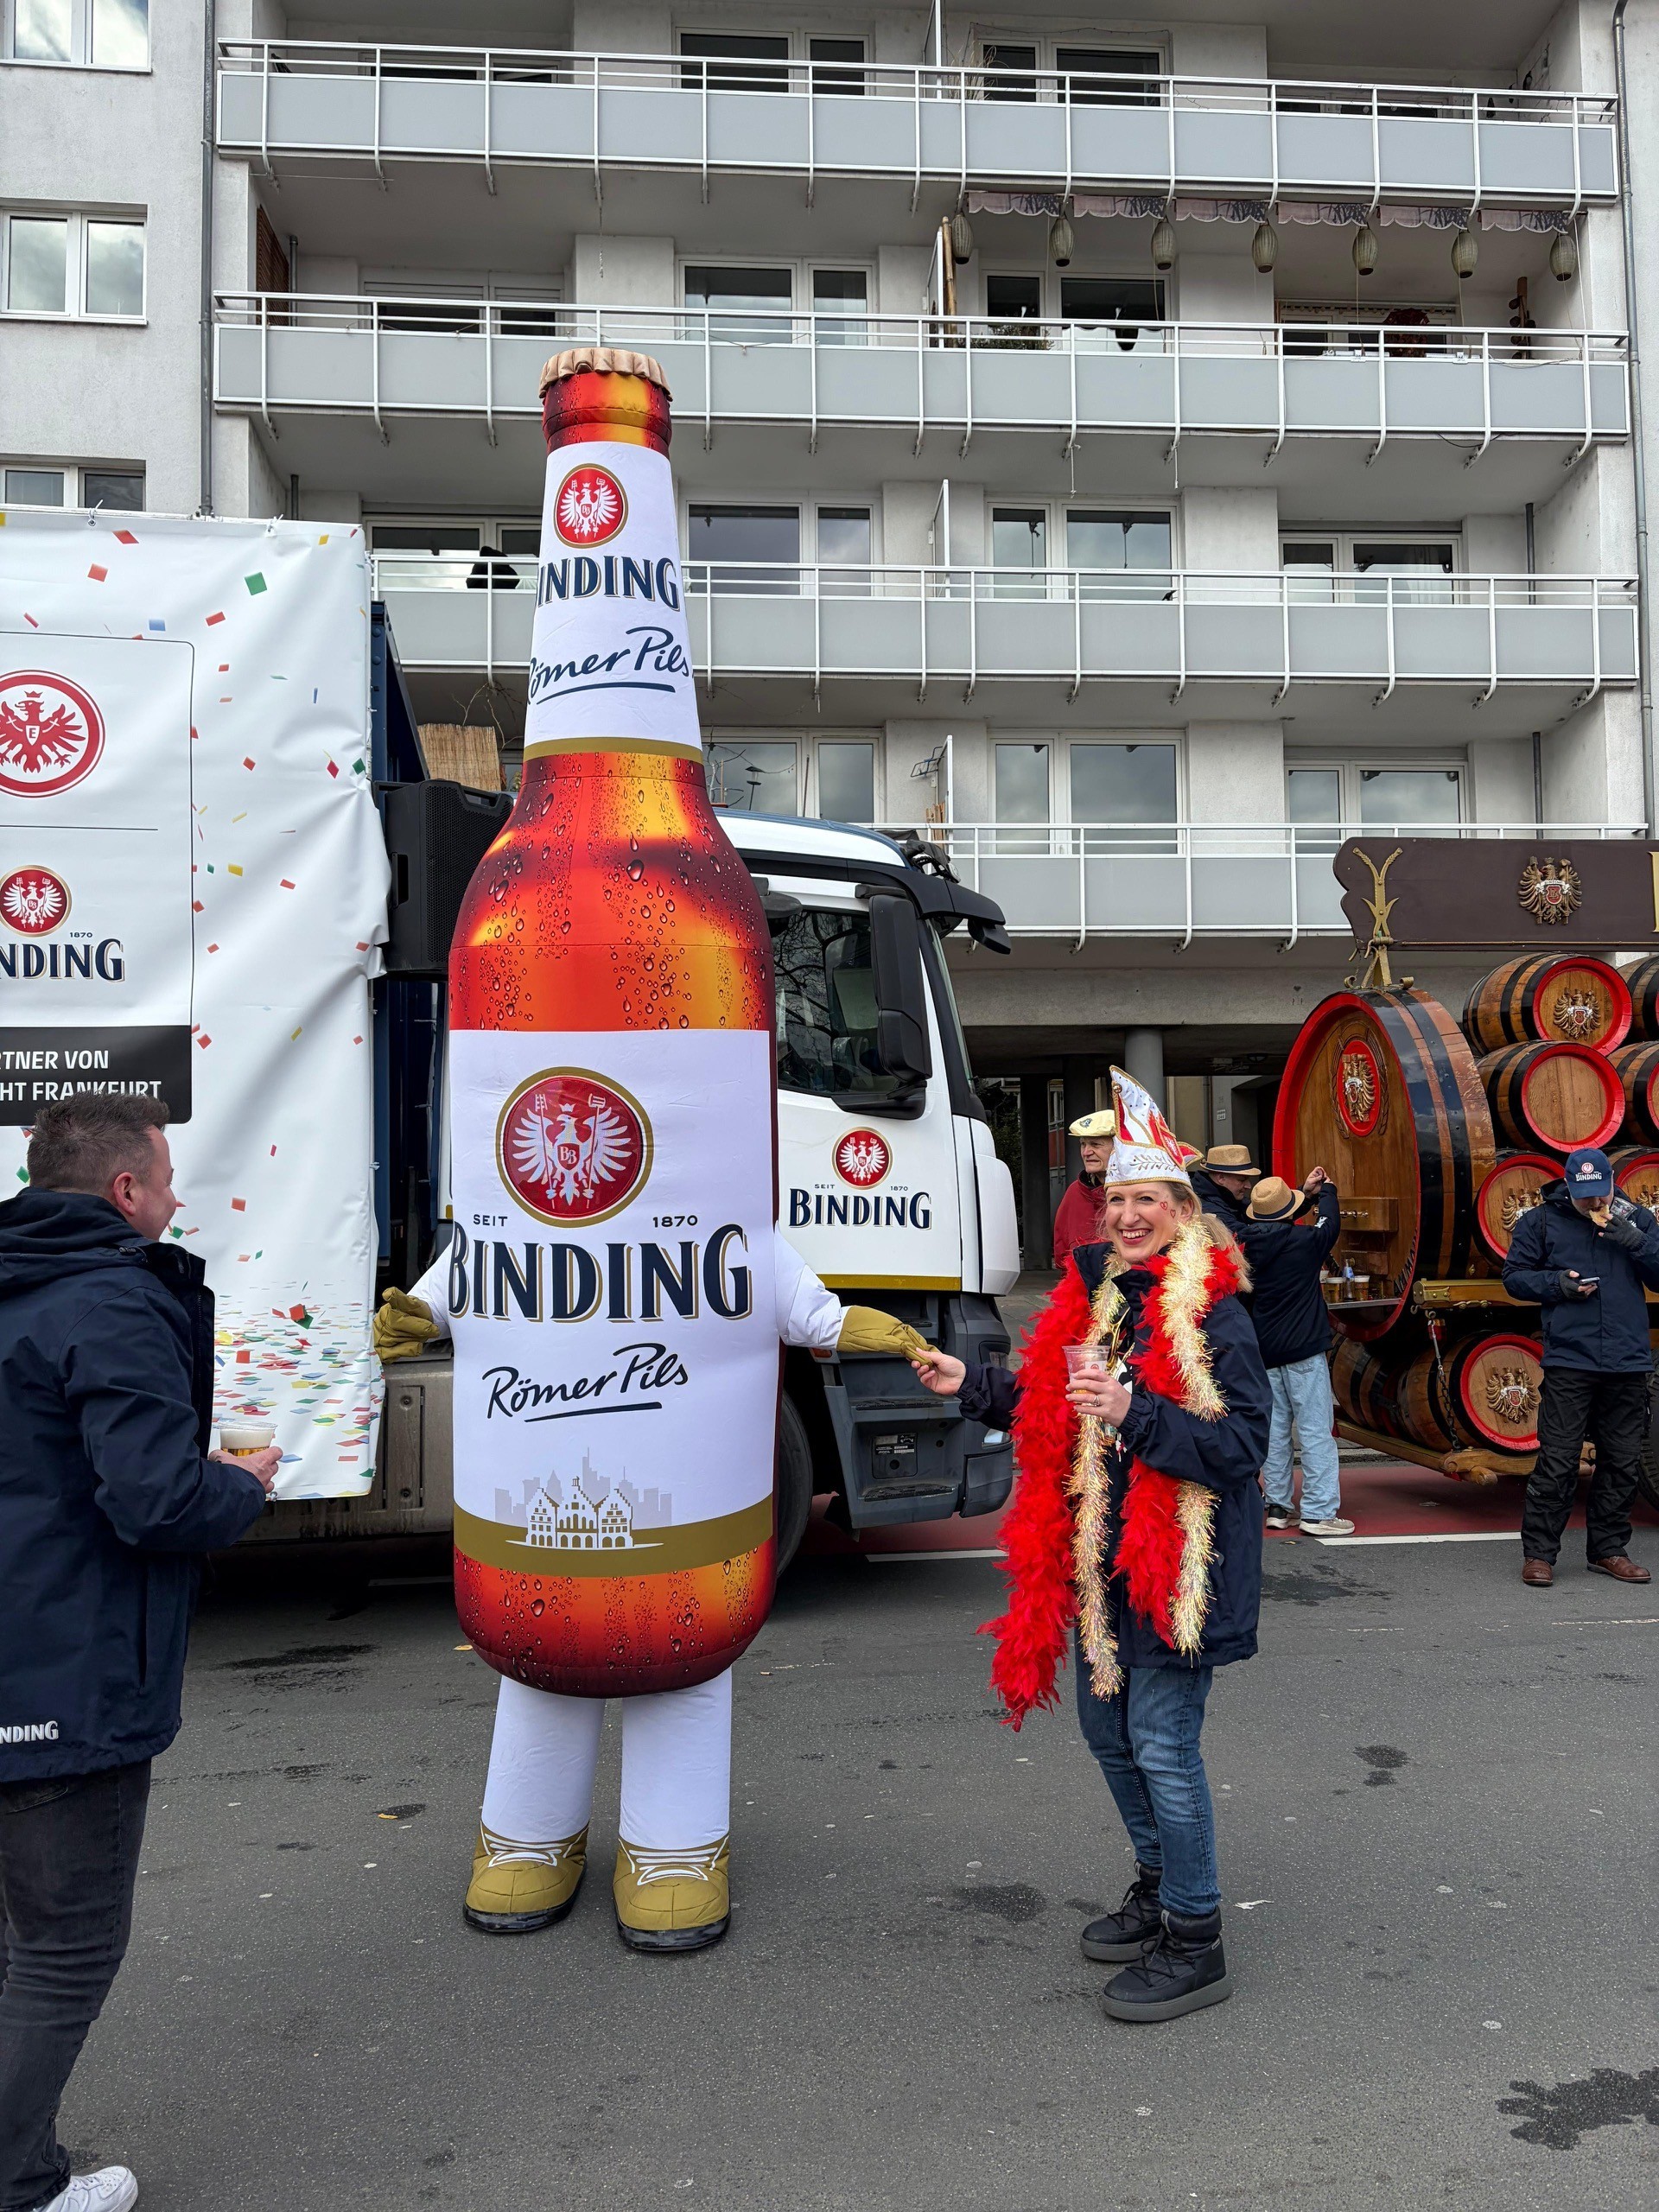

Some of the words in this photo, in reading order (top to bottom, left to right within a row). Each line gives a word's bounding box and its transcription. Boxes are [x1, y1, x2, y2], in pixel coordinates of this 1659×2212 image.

[626, 626, 690, 677] Pils
[29, 728, 36, 739] E
[0, 938, 126, 983] NDING
[0, 1050, 59, 1070] TNER
[65, 1050, 109, 1070] VON
[473, 1213, 509, 1228] SEIT
[652, 1214, 698, 1229] 1870
[788, 1187, 932, 1231] BINDING
[448, 1220, 753, 1324] BINDING
[481, 1365, 618, 1420] Römer
[613, 1342, 690, 1394] Pils
[0, 1719, 60, 1745] NDING
